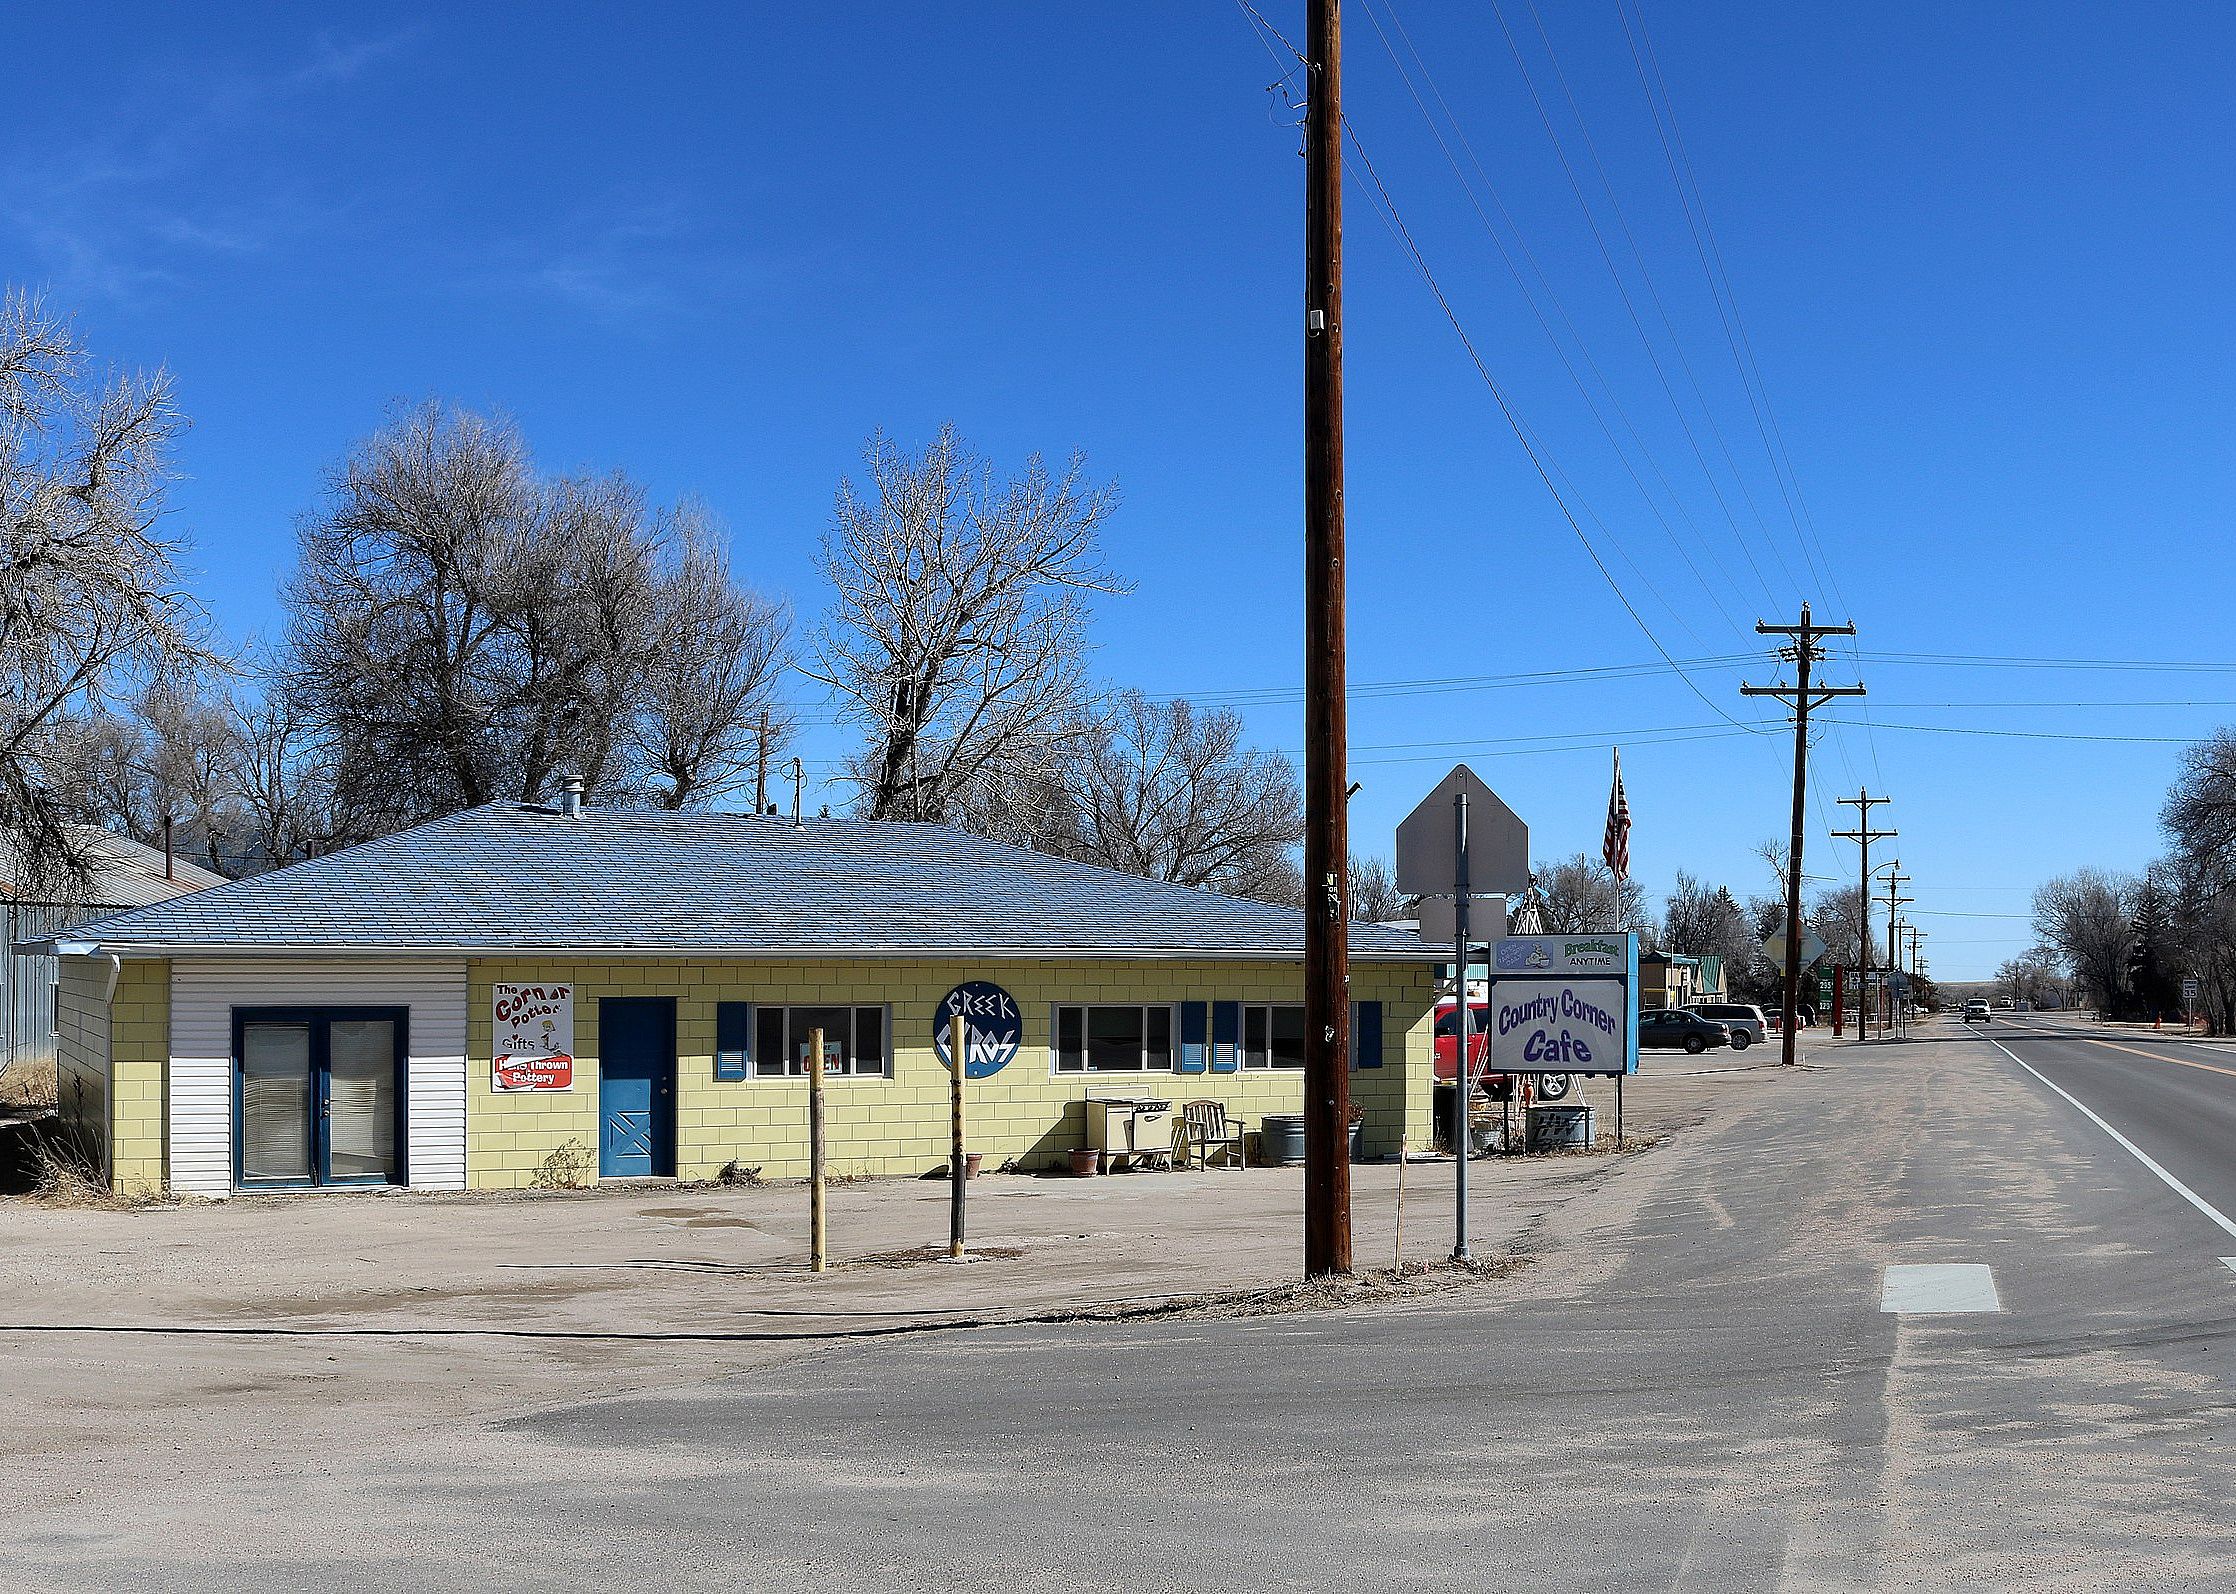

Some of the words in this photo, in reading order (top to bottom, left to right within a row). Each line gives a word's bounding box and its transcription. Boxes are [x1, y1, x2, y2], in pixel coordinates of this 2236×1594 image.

[1564, 939, 1620, 958] Breakfast
[1569, 957, 1611, 966] ANYTIME
[496, 984, 518, 995] The
[947, 990, 1015, 1019] GREEK
[1498, 992, 1559, 1036] Country
[1561, 988, 1617, 1037] Corner
[501, 1034, 536, 1051] Gifts
[1523, 1029, 1592, 1063] Cafe
[803, 1053, 840, 1073] OEN
[512, 1072, 555, 1085] Pottery
